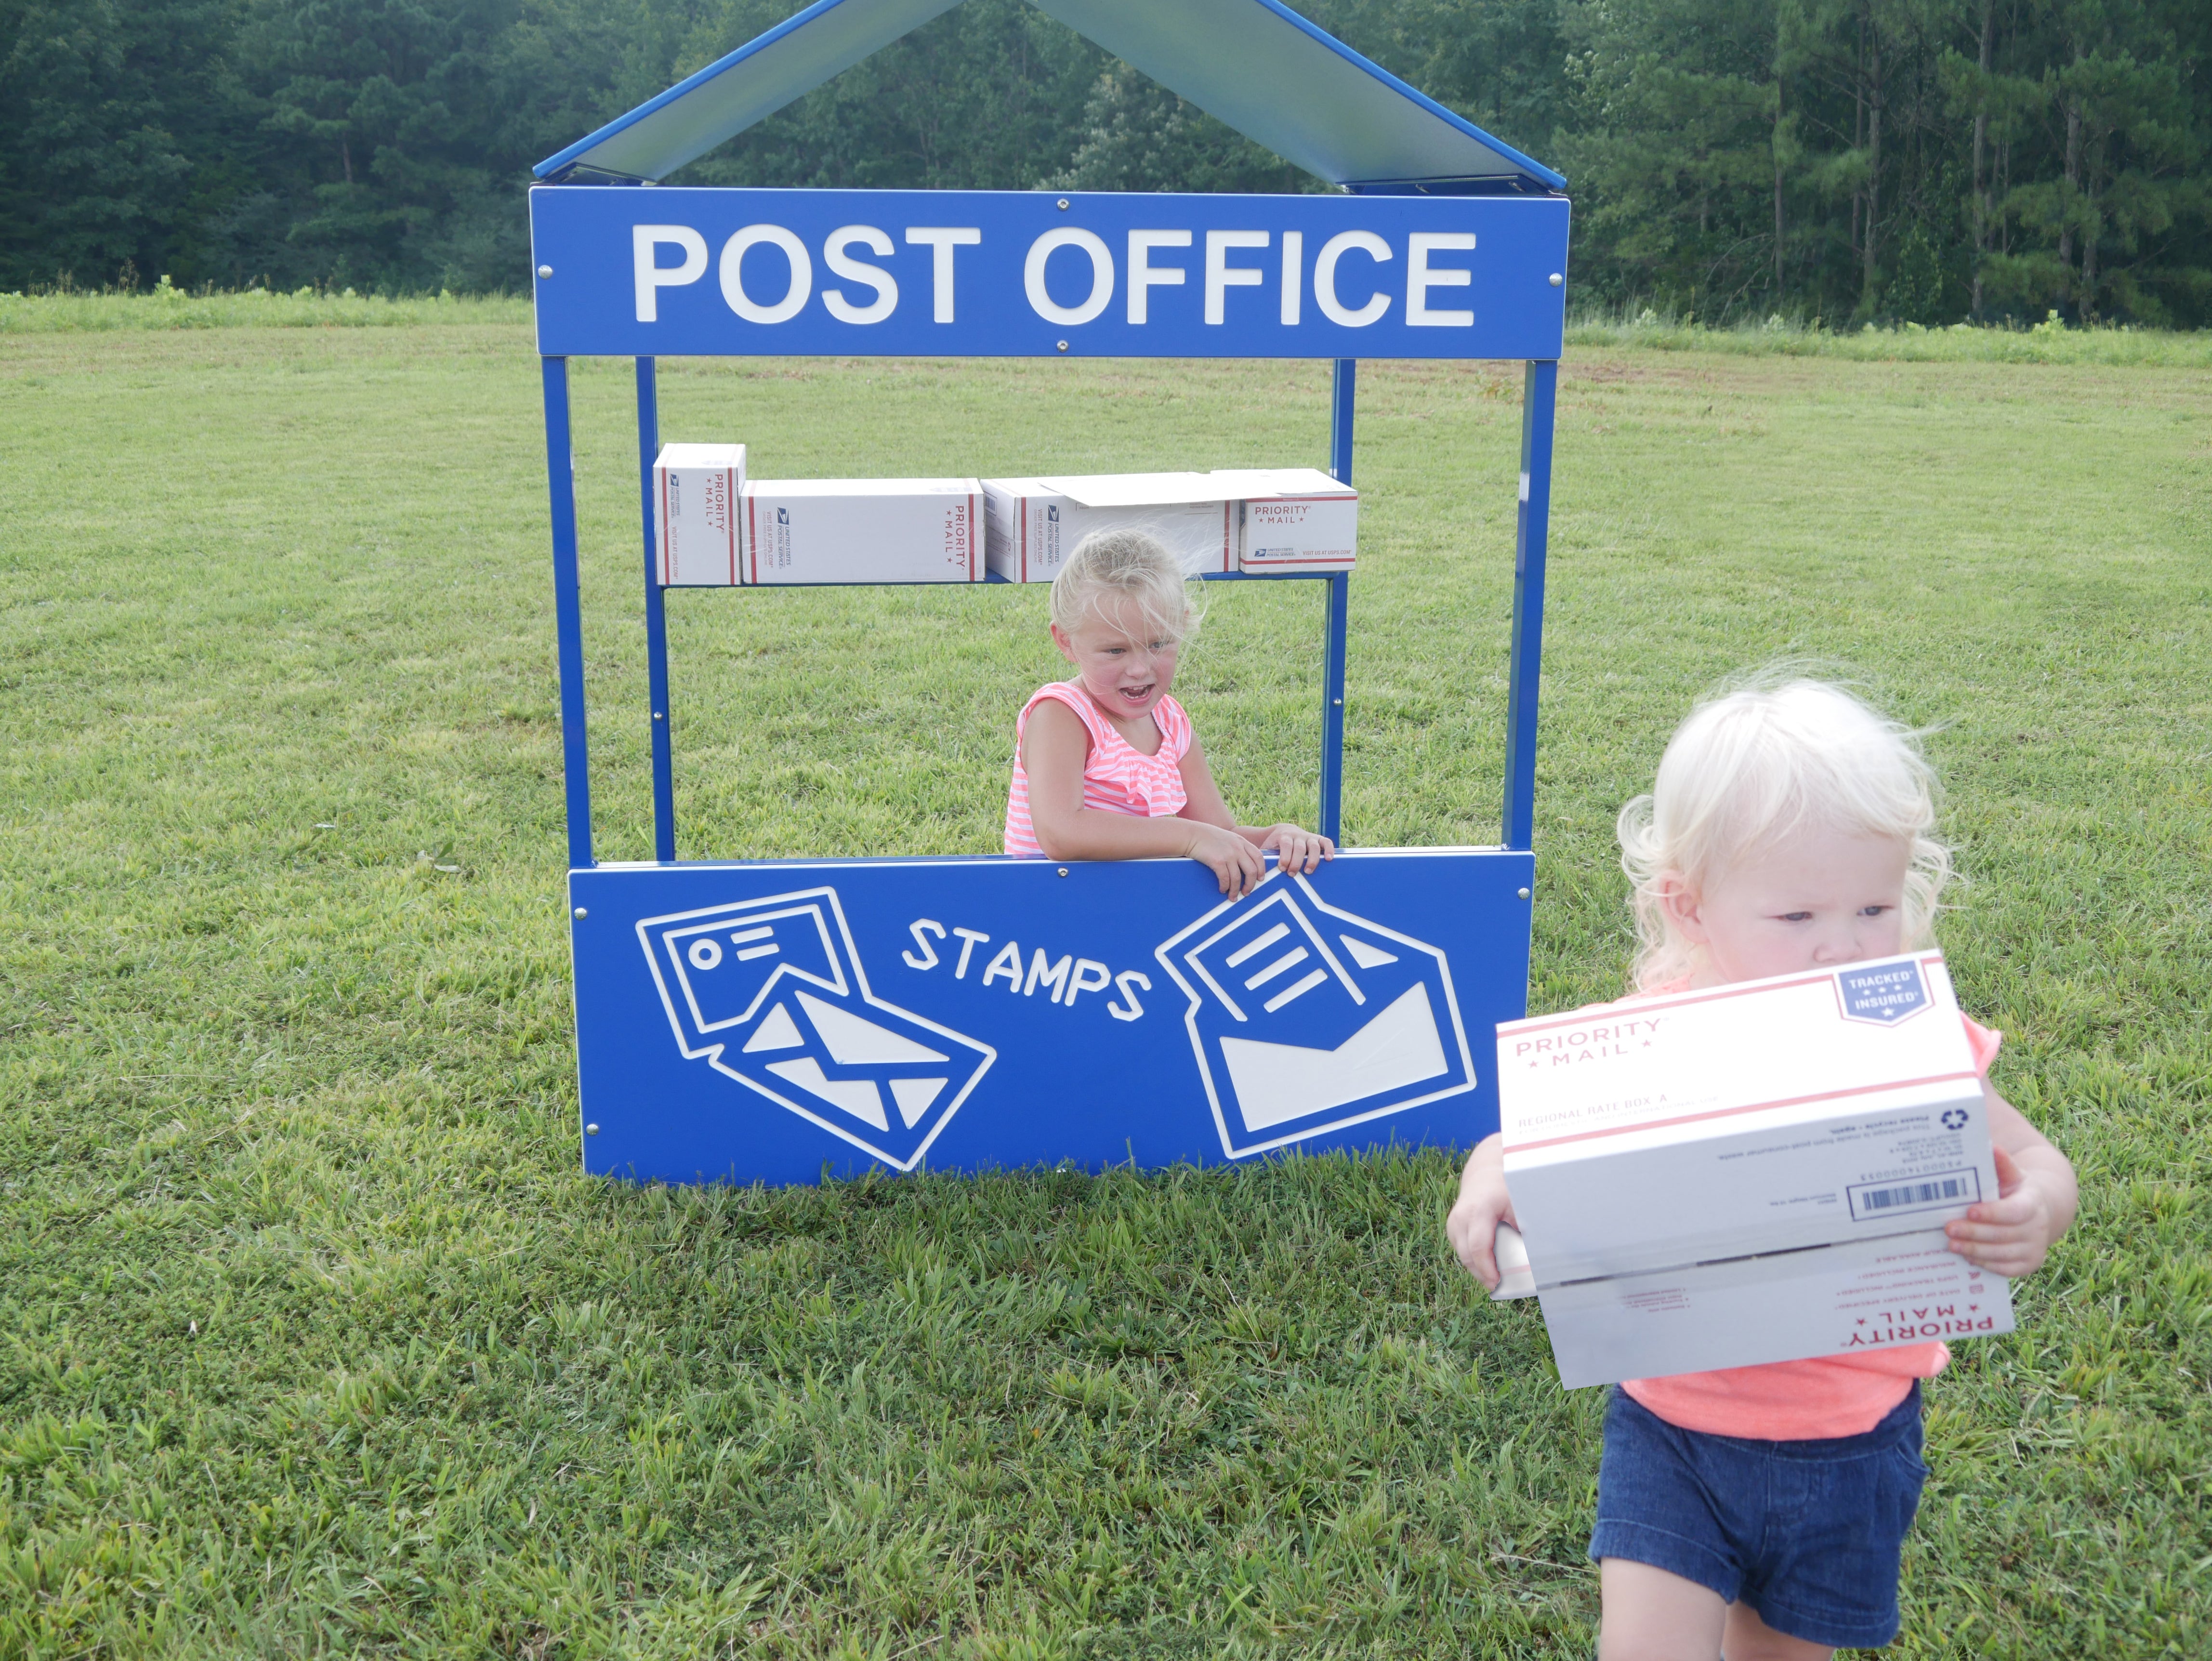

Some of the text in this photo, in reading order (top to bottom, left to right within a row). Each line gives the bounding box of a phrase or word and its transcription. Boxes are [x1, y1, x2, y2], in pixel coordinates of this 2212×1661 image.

[632, 224, 1476, 327] POST OFFICE
[901, 918, 1152, 1022] STAMPS
[1551, 1043, 1628, 1066] MAIL
[1517, 1093, 1667, 1127] REGIONAL RATE BOX A
[1865, 1119, 1897, 1130] recycle
[1900, 1114, 1930, 1125] Please
[1872, 1125, 1910, 1138] package
[1912, 1122, 1931, 1132] This
[1813, 1137, 1834, 1147] from
[1836, 1133, 1861, 1143] made
[1936, 1274, 1958, 1282] USPS
[1938, 1288, 1960, 1296] DATE
[1882, 1292, 1922, 1304] DELIVERY
[1878, 1305, 1955, 1324] MAIL
